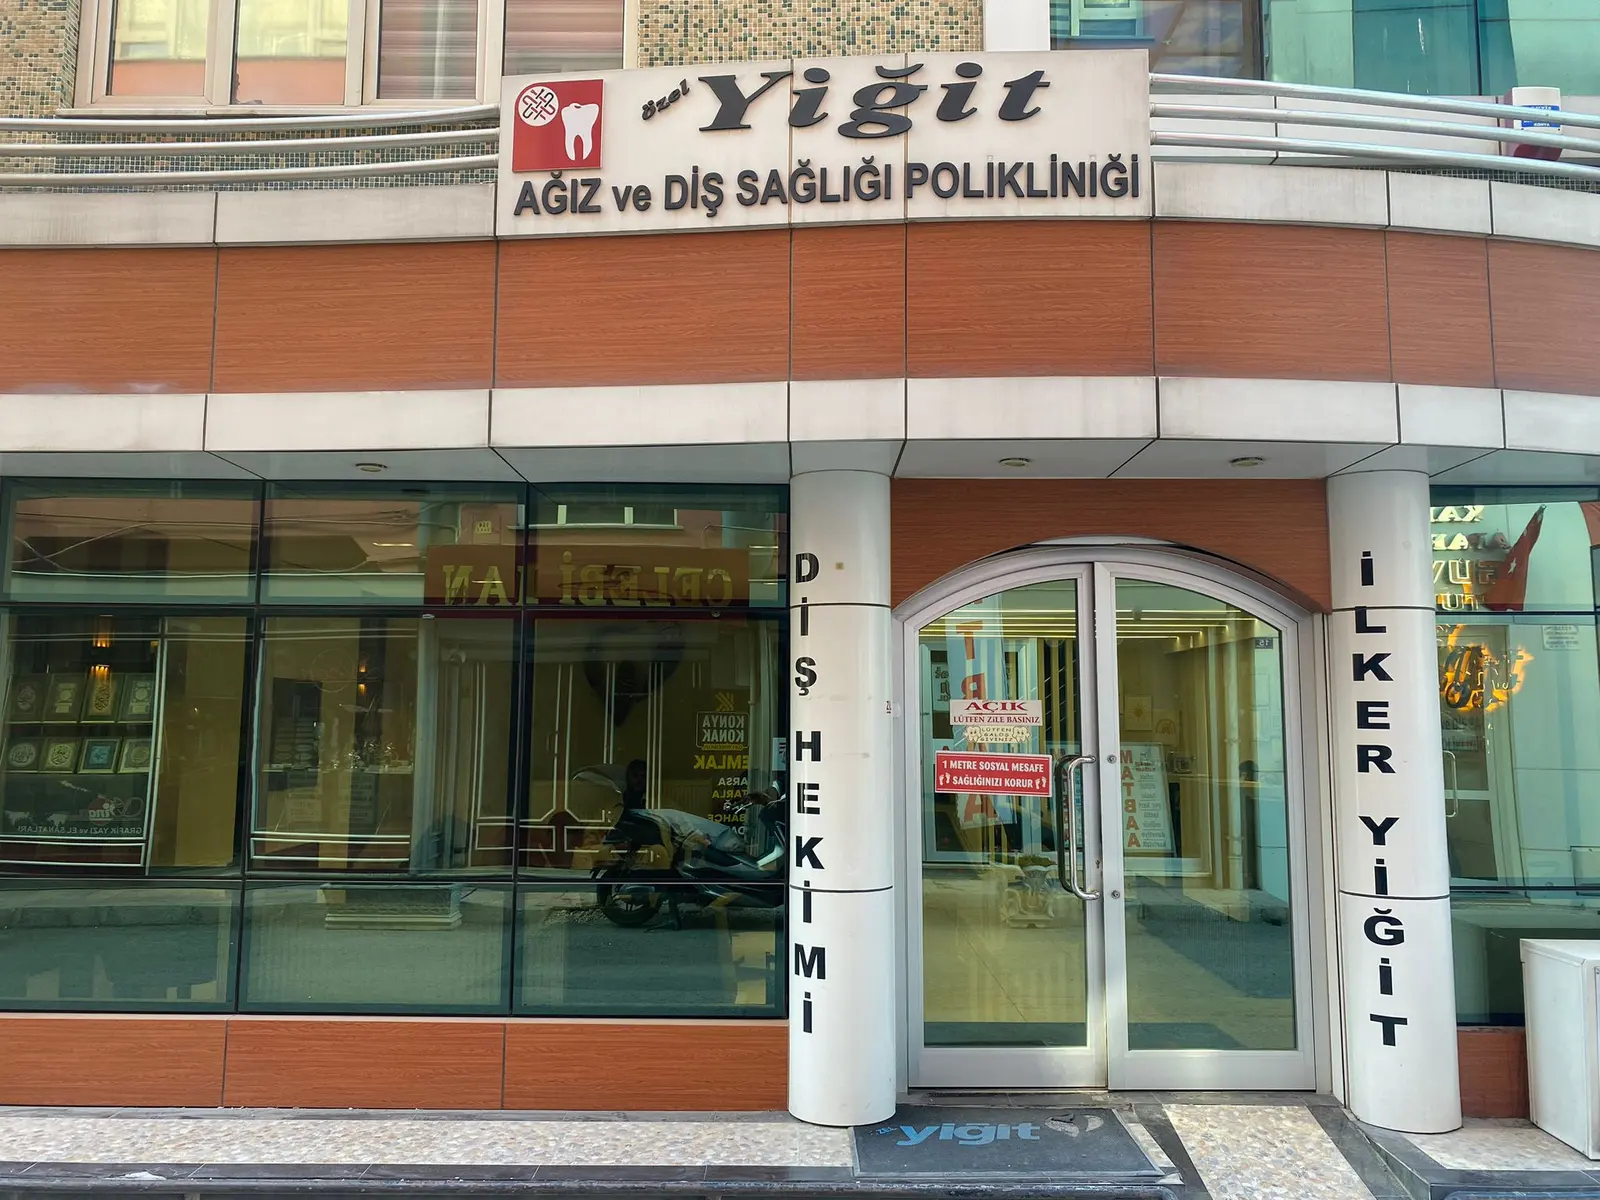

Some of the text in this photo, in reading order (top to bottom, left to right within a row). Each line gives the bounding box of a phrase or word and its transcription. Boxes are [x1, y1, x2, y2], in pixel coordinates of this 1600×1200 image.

[641, 62, 1051, 139] özel Yiğit
[514, 172, 601, 216] AĞIZ
[611, 184, 652, 212] ve
[664, 165, 724, 217] DİŞ
[736, 155, 892, 206] SAĞLIĞI
[953, 714, 986, 723] LÜTFEN
[1006, 715, 1040, 724] BASINIZ
[964, 701, 1028, 713] AÇIK
[942, 760, 1044, 773] 1 METRE SOSYAL MESAFE
[952, 774, 1033, 788] SAĞLIĞINIZI KORUR
[794, 552, 826, 1034] DİŞ HEKİMİ
[1353, 551, 1408, 1048] İLKER YİĞİT
